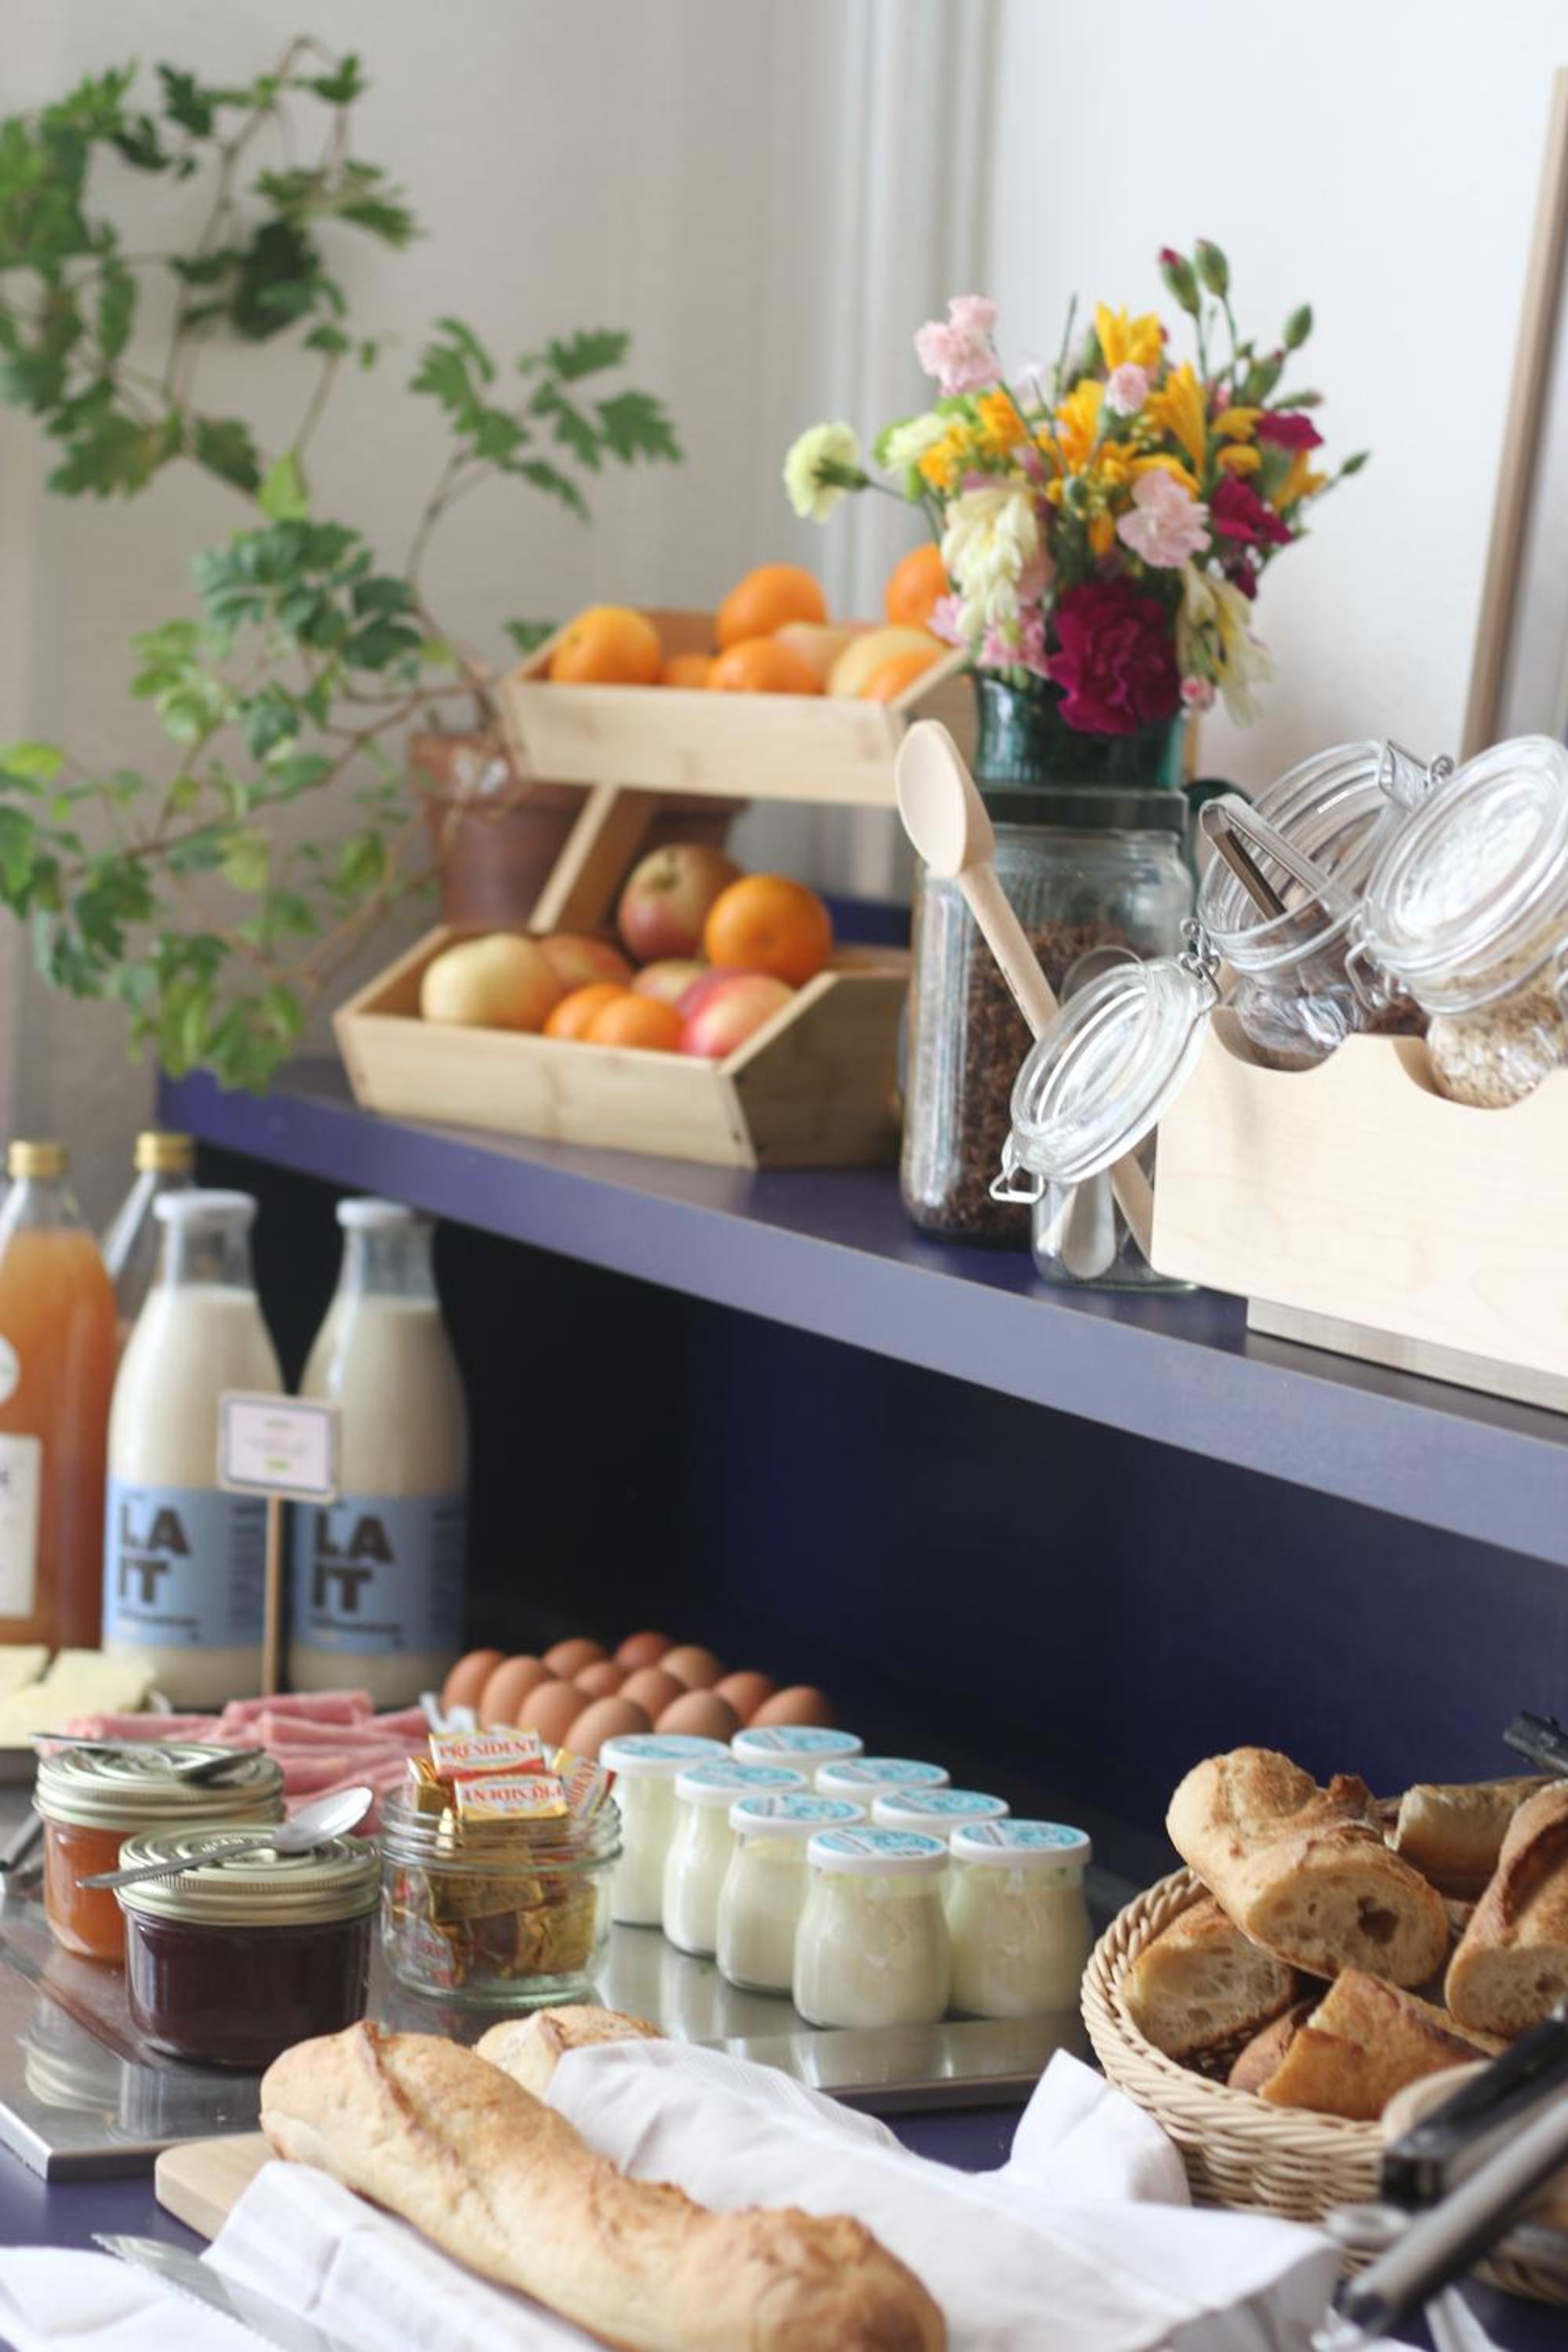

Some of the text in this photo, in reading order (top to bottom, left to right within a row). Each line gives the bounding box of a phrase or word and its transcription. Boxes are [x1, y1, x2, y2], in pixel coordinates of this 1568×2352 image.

[120, 1504, 191, 1555] LA
[316, 1512, 395, 1563] LA
[119, 1556, 170, 1604] IT
[313, 1563, 373, 1613] IT
